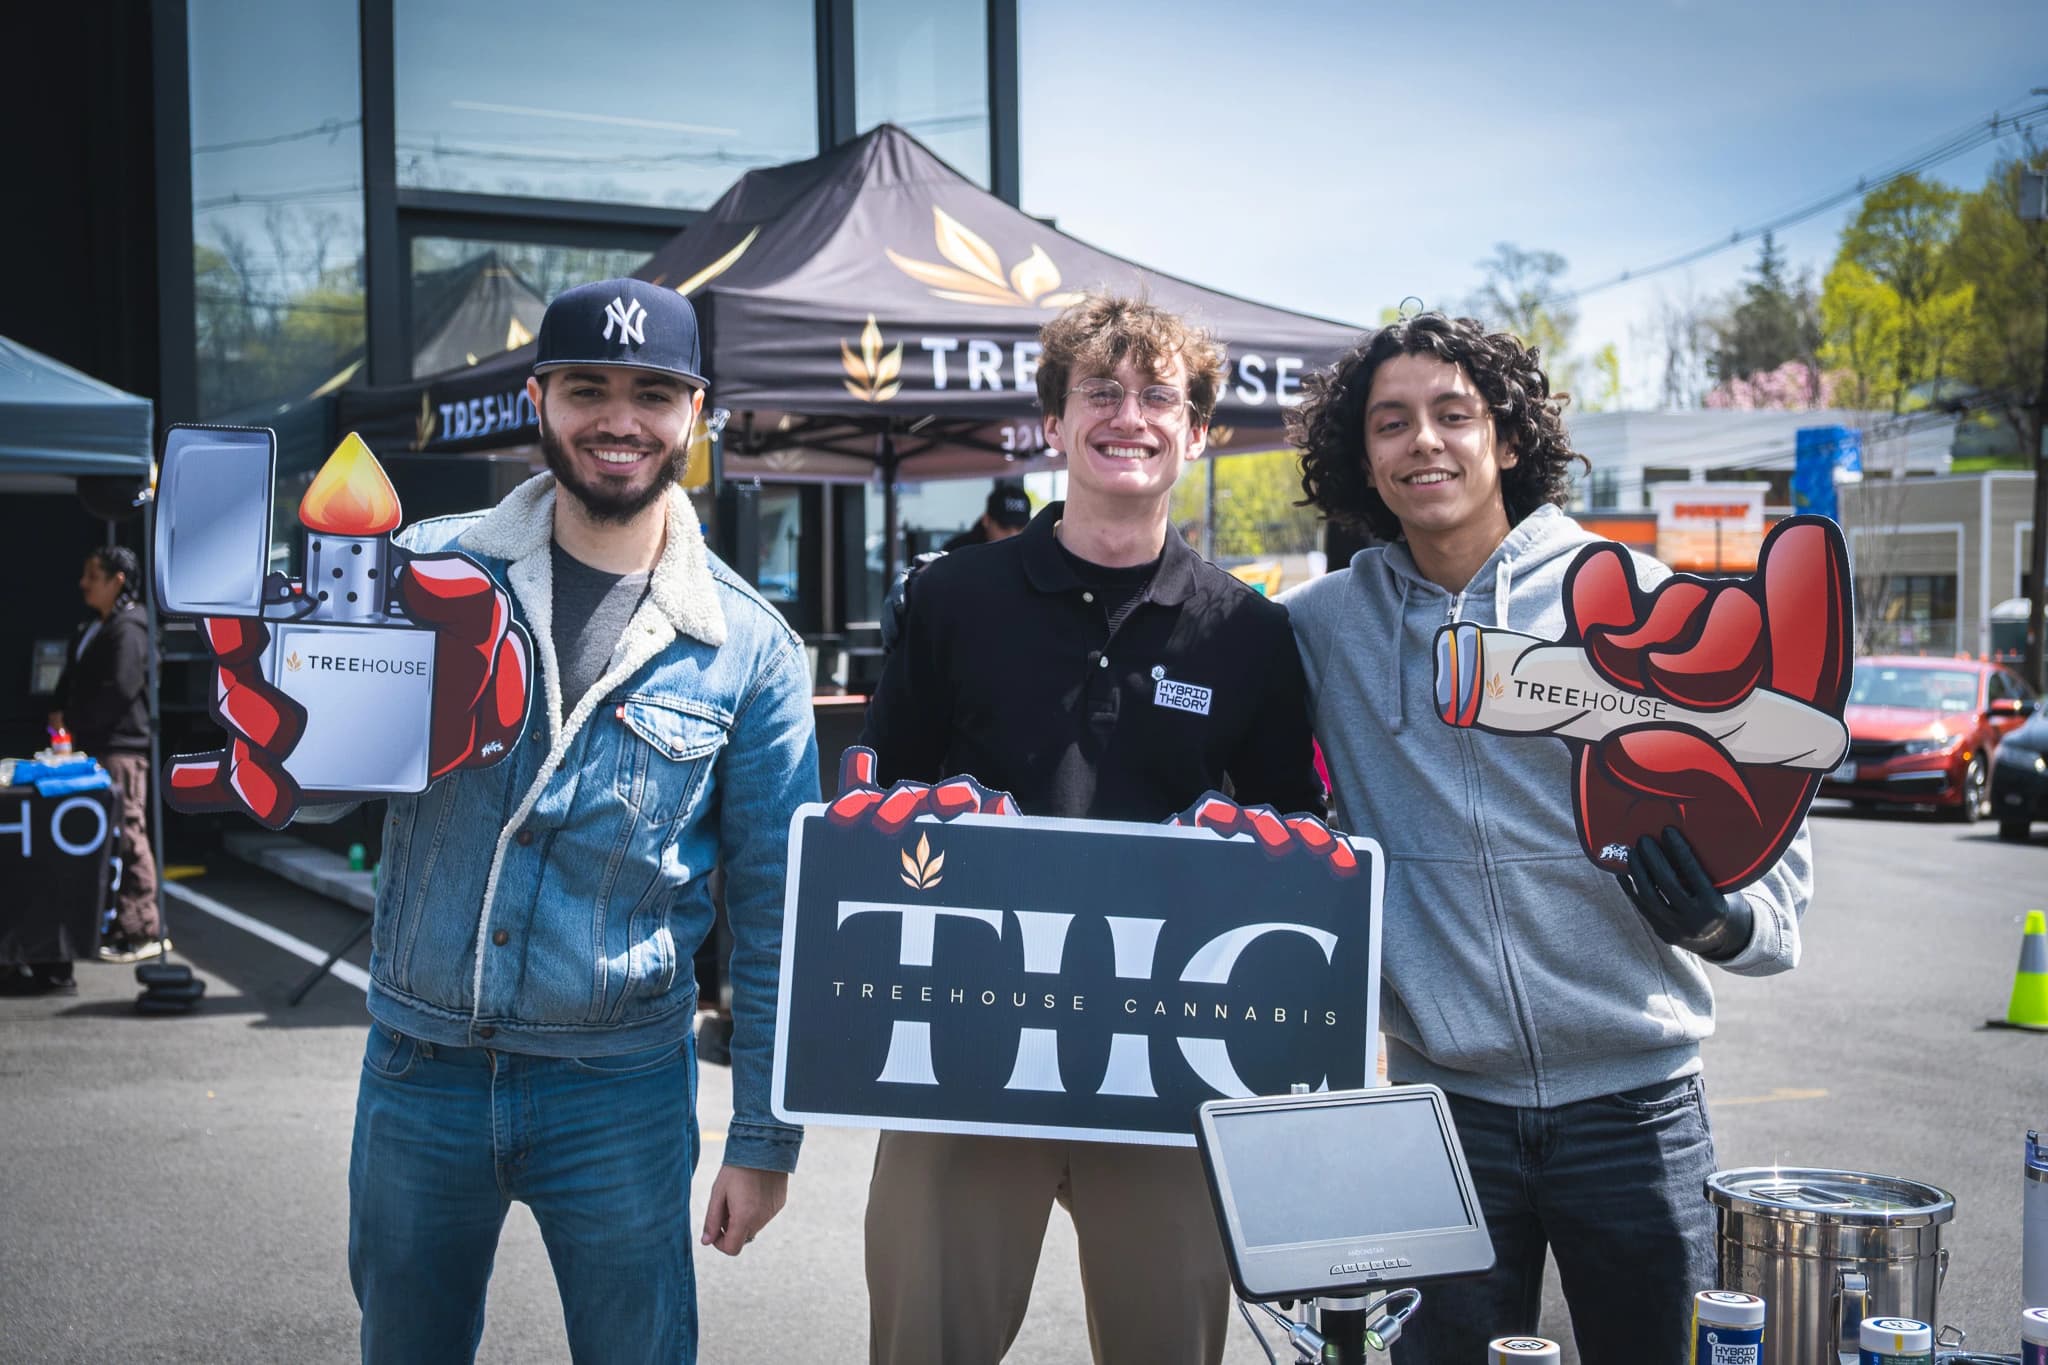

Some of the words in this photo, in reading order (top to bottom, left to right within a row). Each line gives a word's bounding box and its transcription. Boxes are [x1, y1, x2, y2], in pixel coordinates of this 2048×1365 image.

[308, 655, 427, 676] TREEHOUSE
[1160, 681, 1209, 701] HYBRID
[1513, 679, 1668, 721] TREEHOUSE
[1159, 692, 1207, 711] THEORY
[832, 981, 1085, 1011] TREEHOUSE
[1124, 998, 1337, 1026] CANNABIS
[1715, 1346, 1756, 1356] HYBRID
[1715, 1354, 1756, 1365] THEORY
